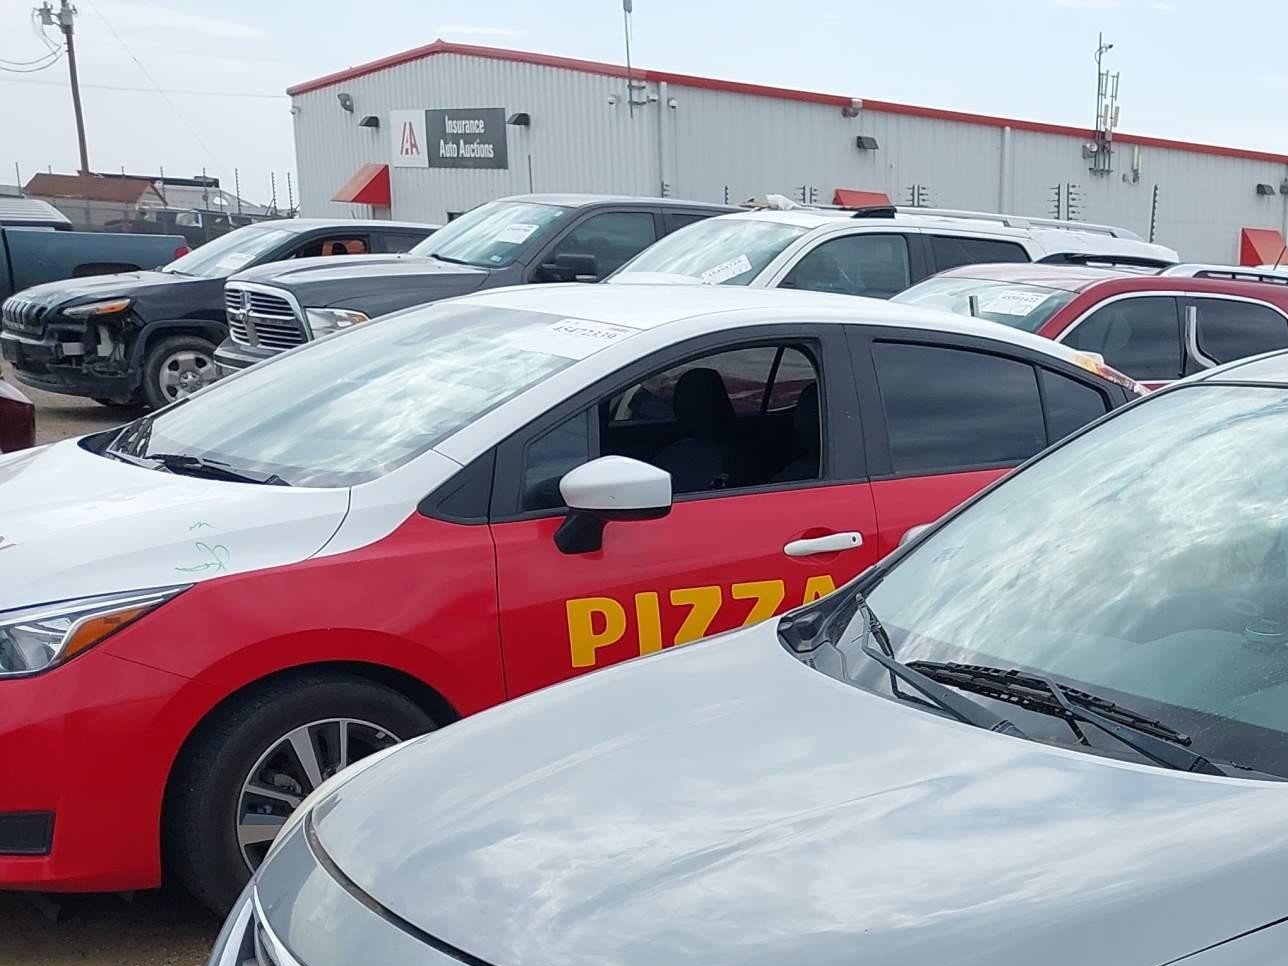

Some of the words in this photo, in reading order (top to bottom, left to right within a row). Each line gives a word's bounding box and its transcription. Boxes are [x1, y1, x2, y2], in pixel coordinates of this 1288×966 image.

[444, 115, 485, 134] Insurance
[439, 138, 458, 158] Auto
[459, 138, 494, 158] Auctions
